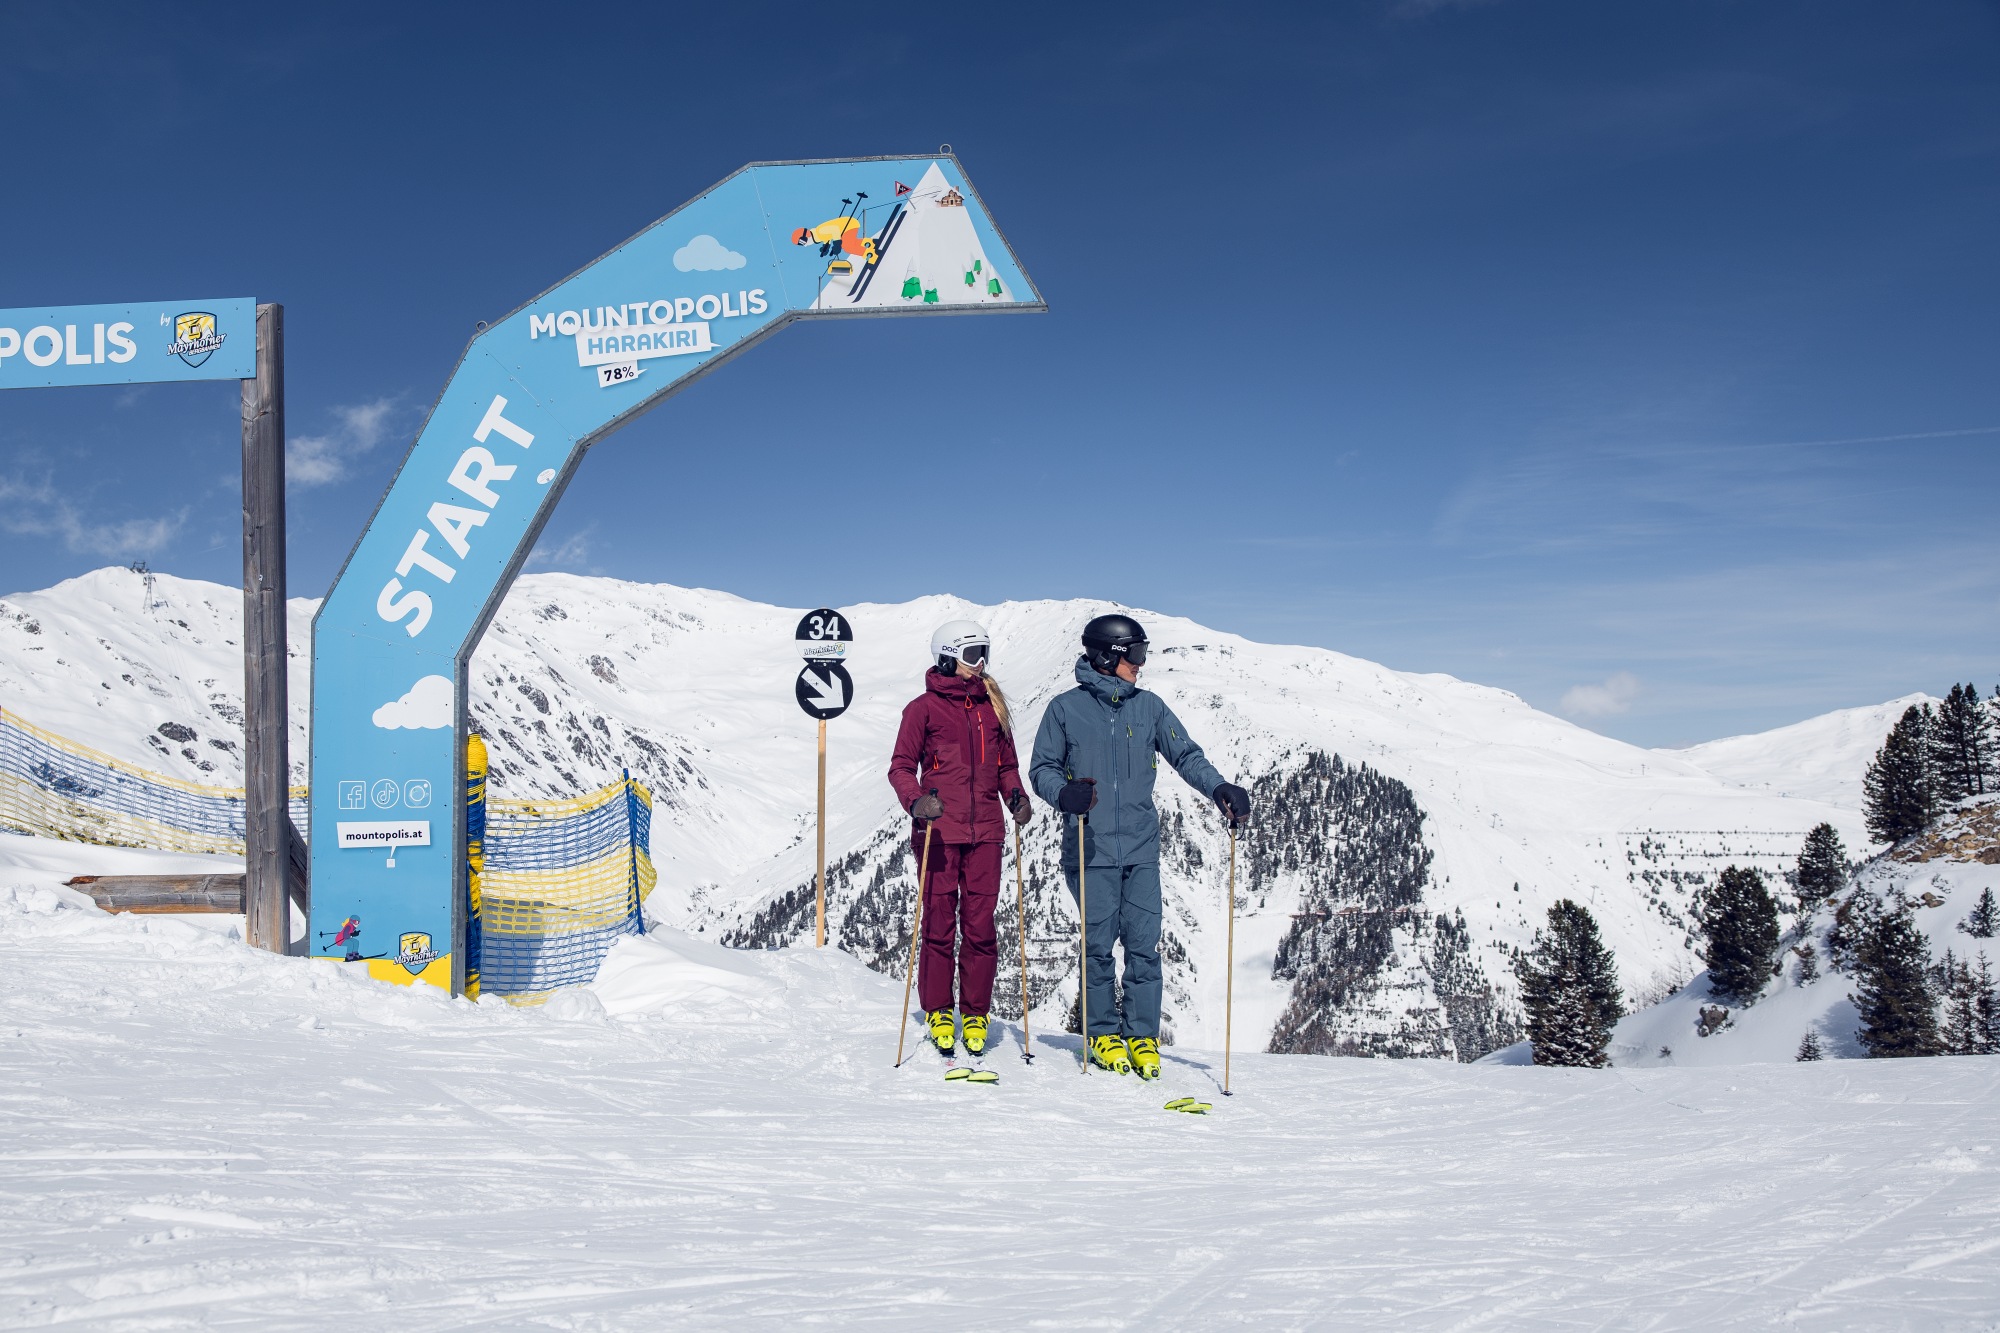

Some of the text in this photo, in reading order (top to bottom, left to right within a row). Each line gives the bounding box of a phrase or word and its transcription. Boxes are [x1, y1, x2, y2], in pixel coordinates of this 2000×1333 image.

[160, 312, 171, 327] by
[529, 288, 768, 340] MOUNTOPOLIS
[167, 333, 227, 356] Mayrhofner
[588, 329, 698, 356] HARAKIRI
[603, 366, 635, 382] 78%
[376, 394, 535, 638] START
[808, 615, 841, 640] 34
[346, 829, 423, 842] mountopolis.at
